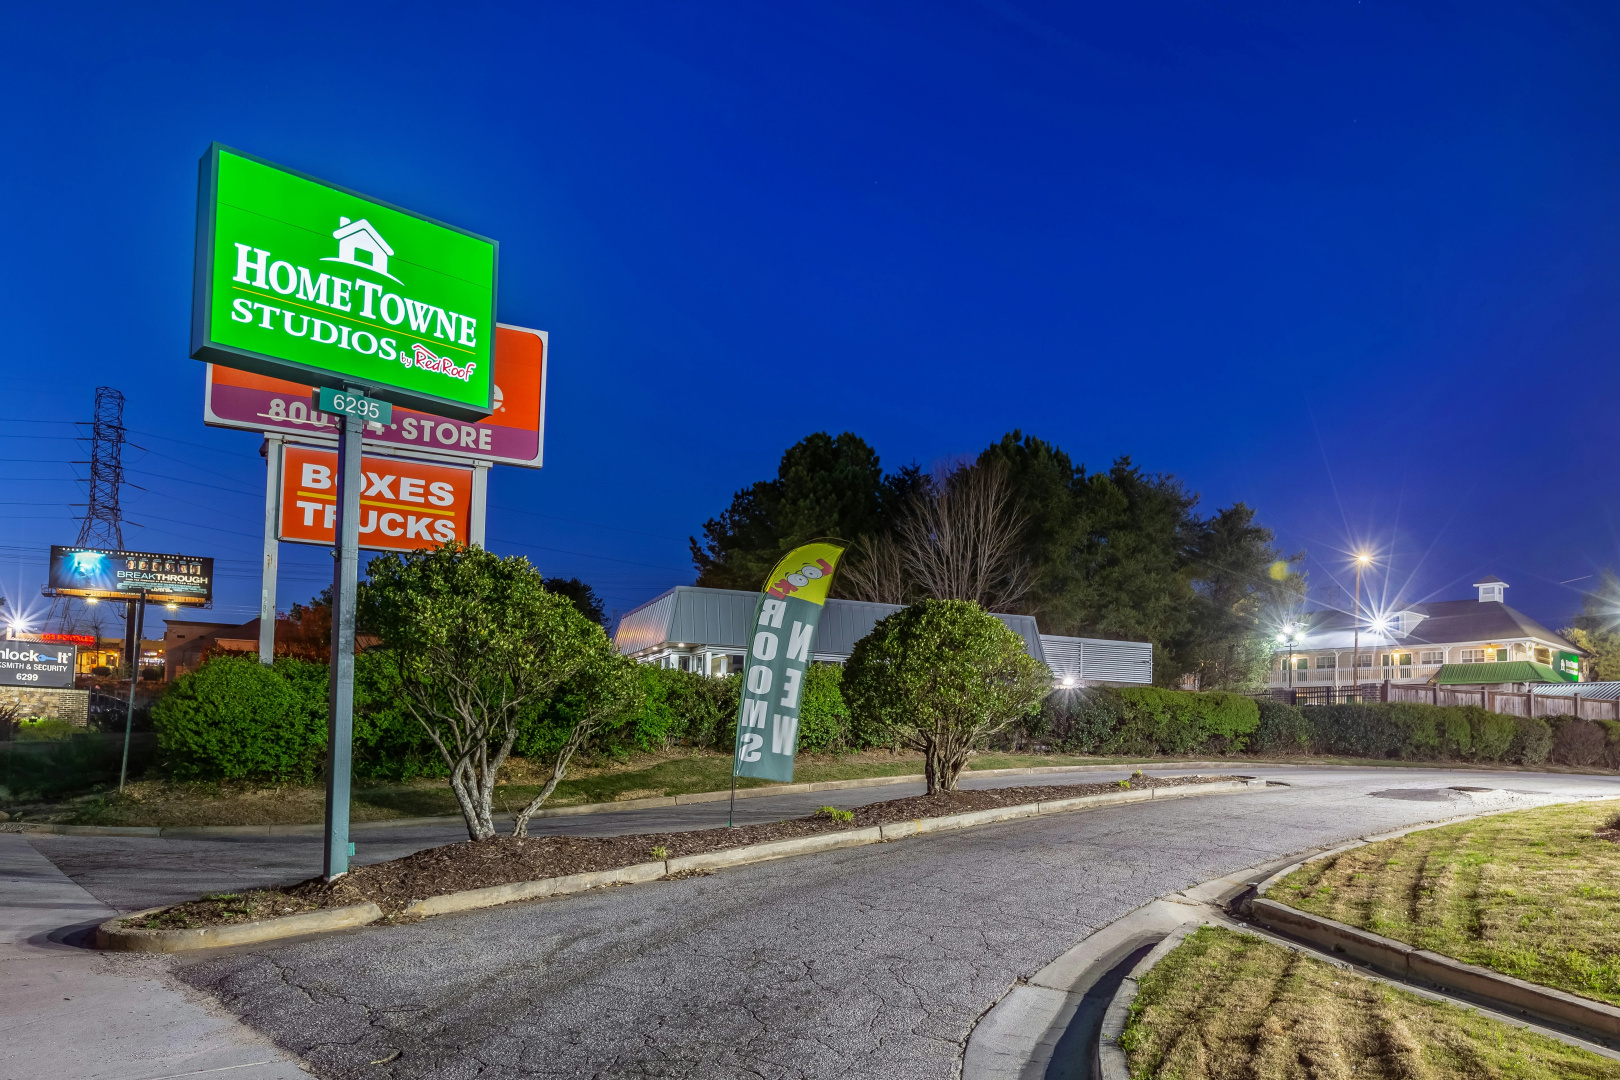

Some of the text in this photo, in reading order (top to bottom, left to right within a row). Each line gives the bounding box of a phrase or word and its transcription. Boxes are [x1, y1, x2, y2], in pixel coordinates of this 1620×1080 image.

[231, 298, 397, 360] STUDIOS
[401, 351, 412, 368] by
[333, 394, 380, 419] 6295
[301, 462, 455, 507] BXES
[116, 570, 209, 584] BREAKTHROUGH
[25, 663, 32, 671] &
[33, 663, 68, 673] SECURITY
[16, 672, 39, 682] 6299
